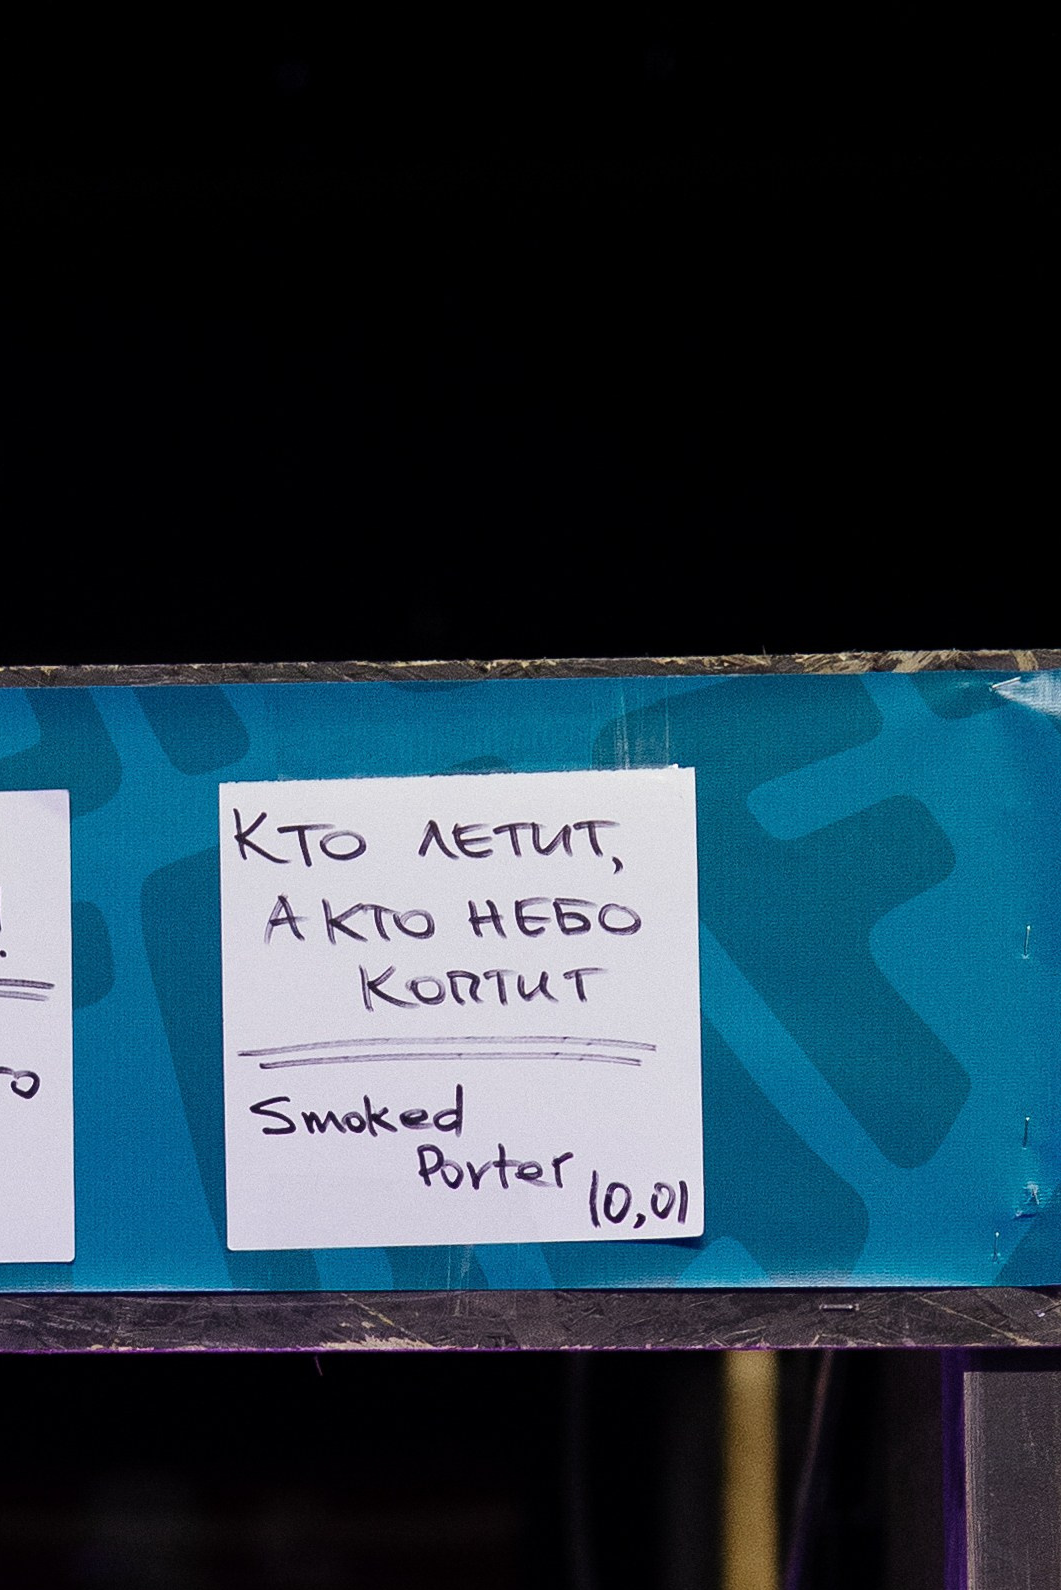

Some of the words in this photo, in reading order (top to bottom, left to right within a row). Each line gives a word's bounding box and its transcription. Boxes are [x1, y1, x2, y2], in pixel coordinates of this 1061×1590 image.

[417, 818, 625, 875] ЛЕТИТ,
[321, 897, 437, 945] КТО
[467, 896, 643, 940] НЕБО
[357, 963, 610, 1013] КОПТИТ
[248, 1083, 465, 1138] Smoked
[416, 1142, 575, 1191] Porter
